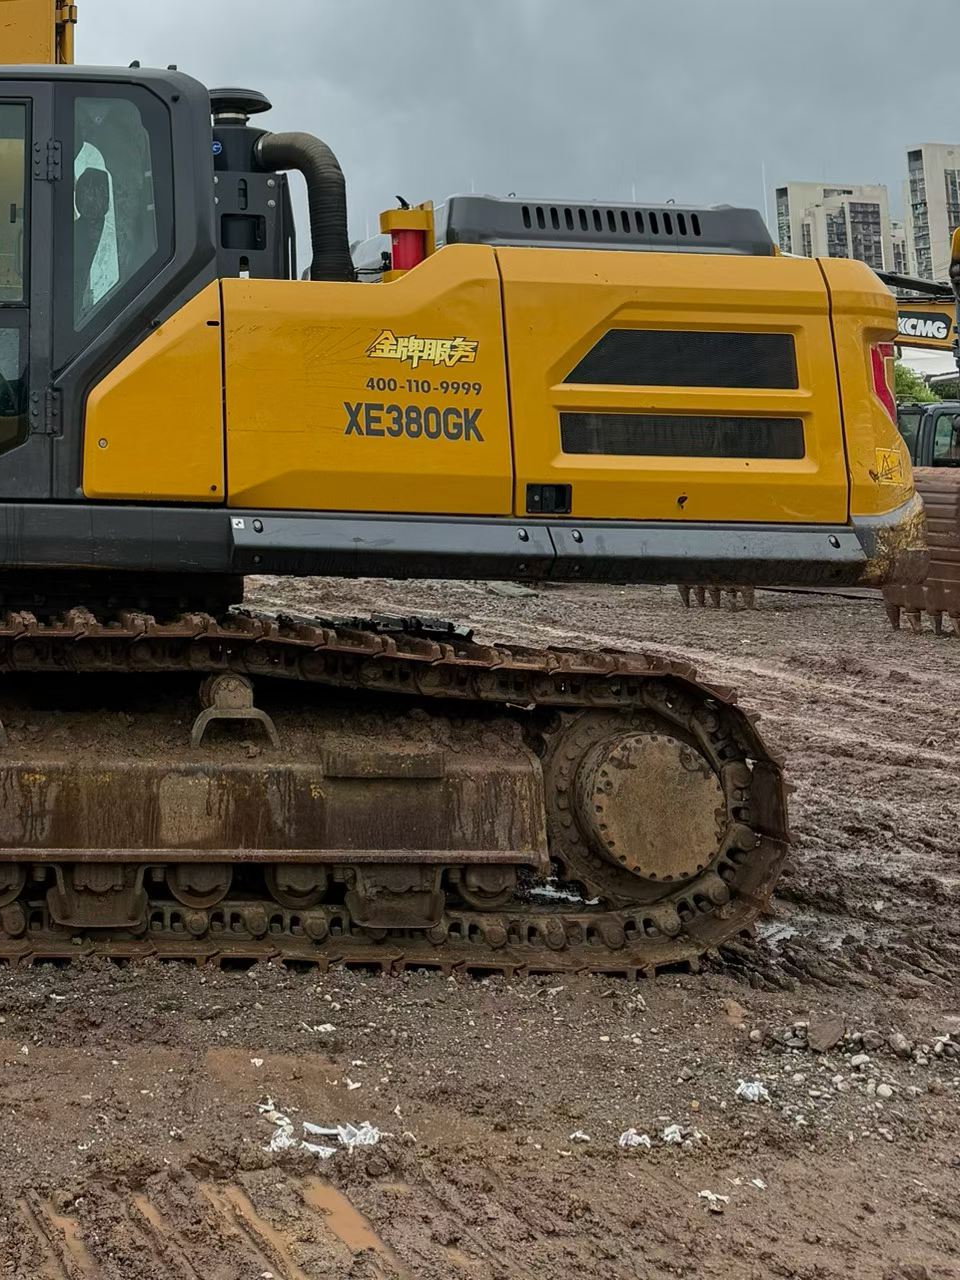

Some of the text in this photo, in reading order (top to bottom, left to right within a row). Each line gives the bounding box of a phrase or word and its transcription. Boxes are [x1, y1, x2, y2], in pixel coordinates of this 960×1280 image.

[365, 329, 479, 369] 金牌服务
[366, 377, 482, 395] 400-110-9999
[343, 401, 485, 442] XE380GK
